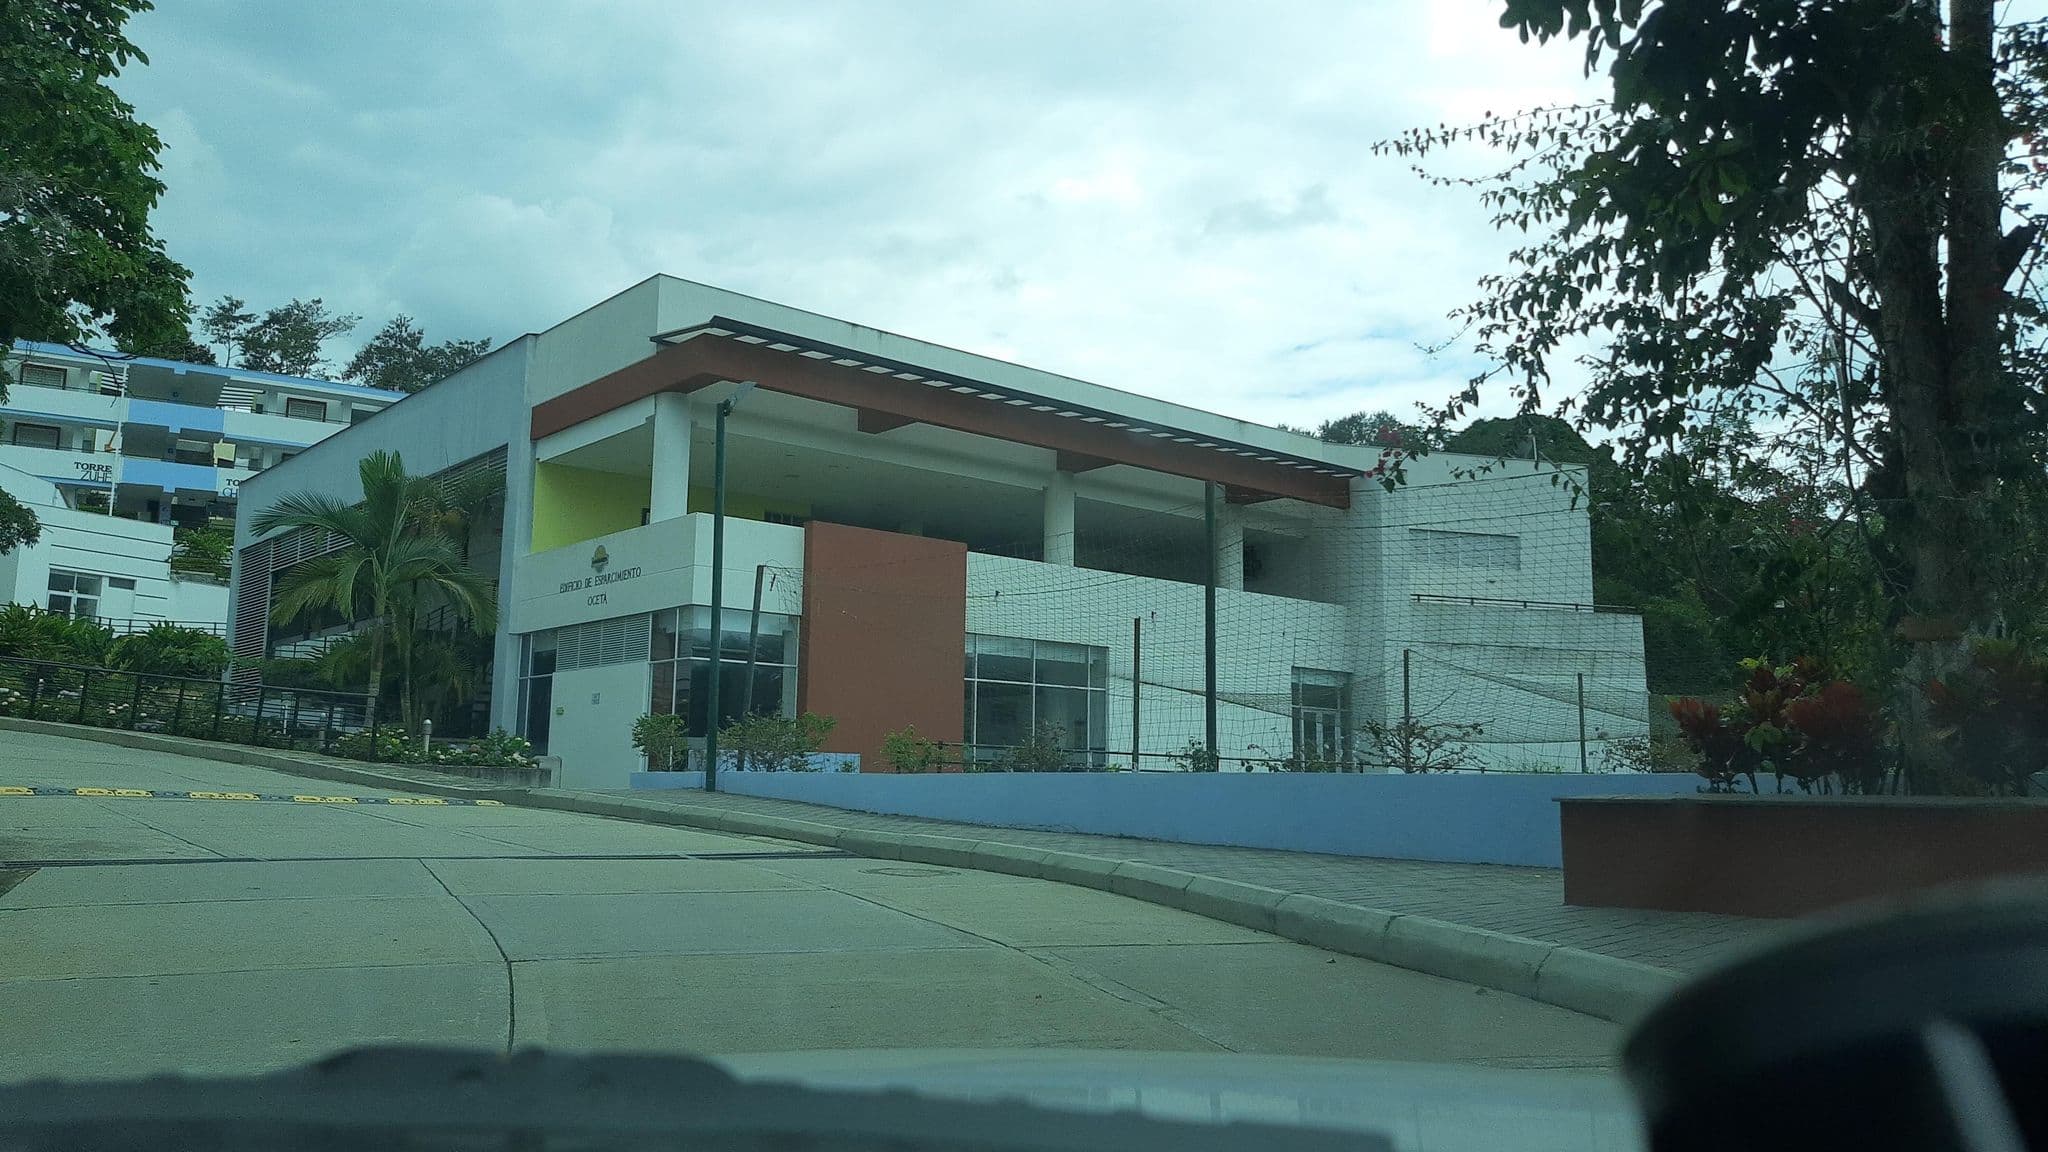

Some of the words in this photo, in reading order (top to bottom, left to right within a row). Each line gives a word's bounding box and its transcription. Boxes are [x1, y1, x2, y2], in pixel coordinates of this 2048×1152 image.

[74, 461, 113, 472] TORRE
[80, 470, 113, 482] ZUHE
[559, 580, 582, 593] EDIFICIO
[585, 577, 592, 588] DE
[594, 566, 641, 586] ESPARCIMIENTO
